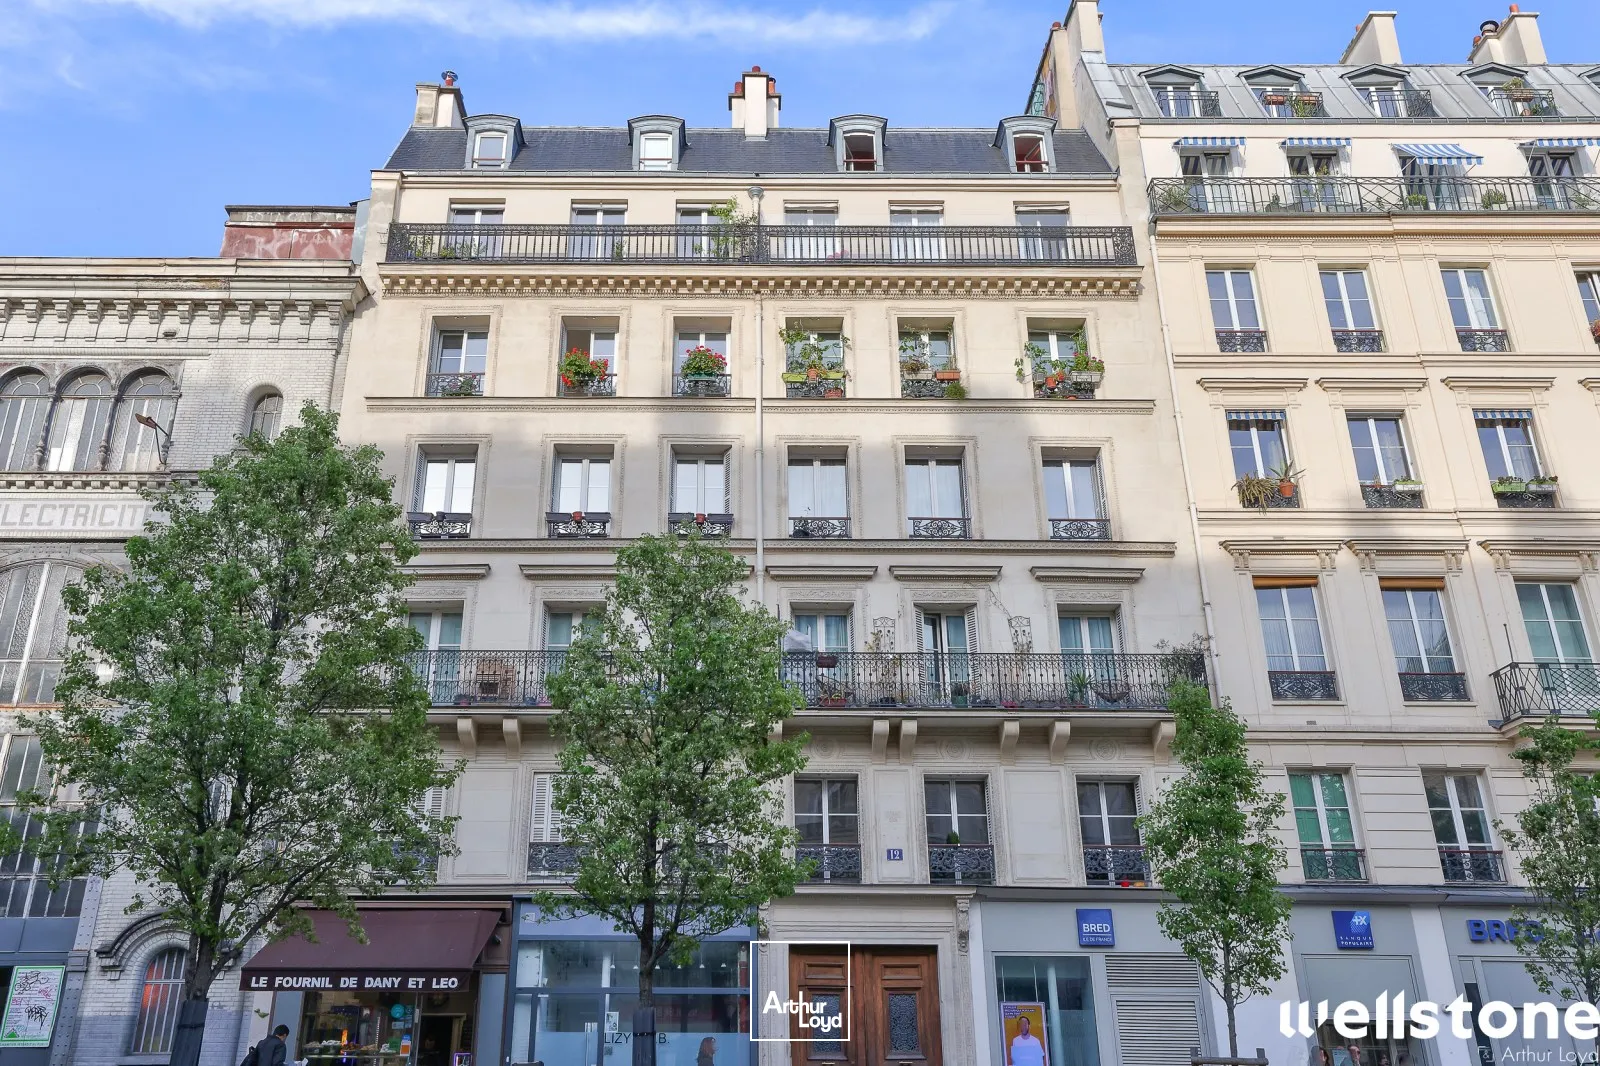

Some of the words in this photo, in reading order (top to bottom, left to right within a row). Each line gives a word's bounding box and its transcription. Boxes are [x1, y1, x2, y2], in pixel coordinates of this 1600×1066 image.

[890, 849, 900, 860] 12
[1082, 923, 1111, 933] BRED
[250, 976, 268, 988] LE
[274, 976, 333, 988] FOURNIL
[339, 977, 358, 988] DE
[364, 977, 402, 988] DANY
[407, 977, 426, 989] ET
[431, 977, 459, 989] LEO
[604, 1032, 631, 1044] LIZY
